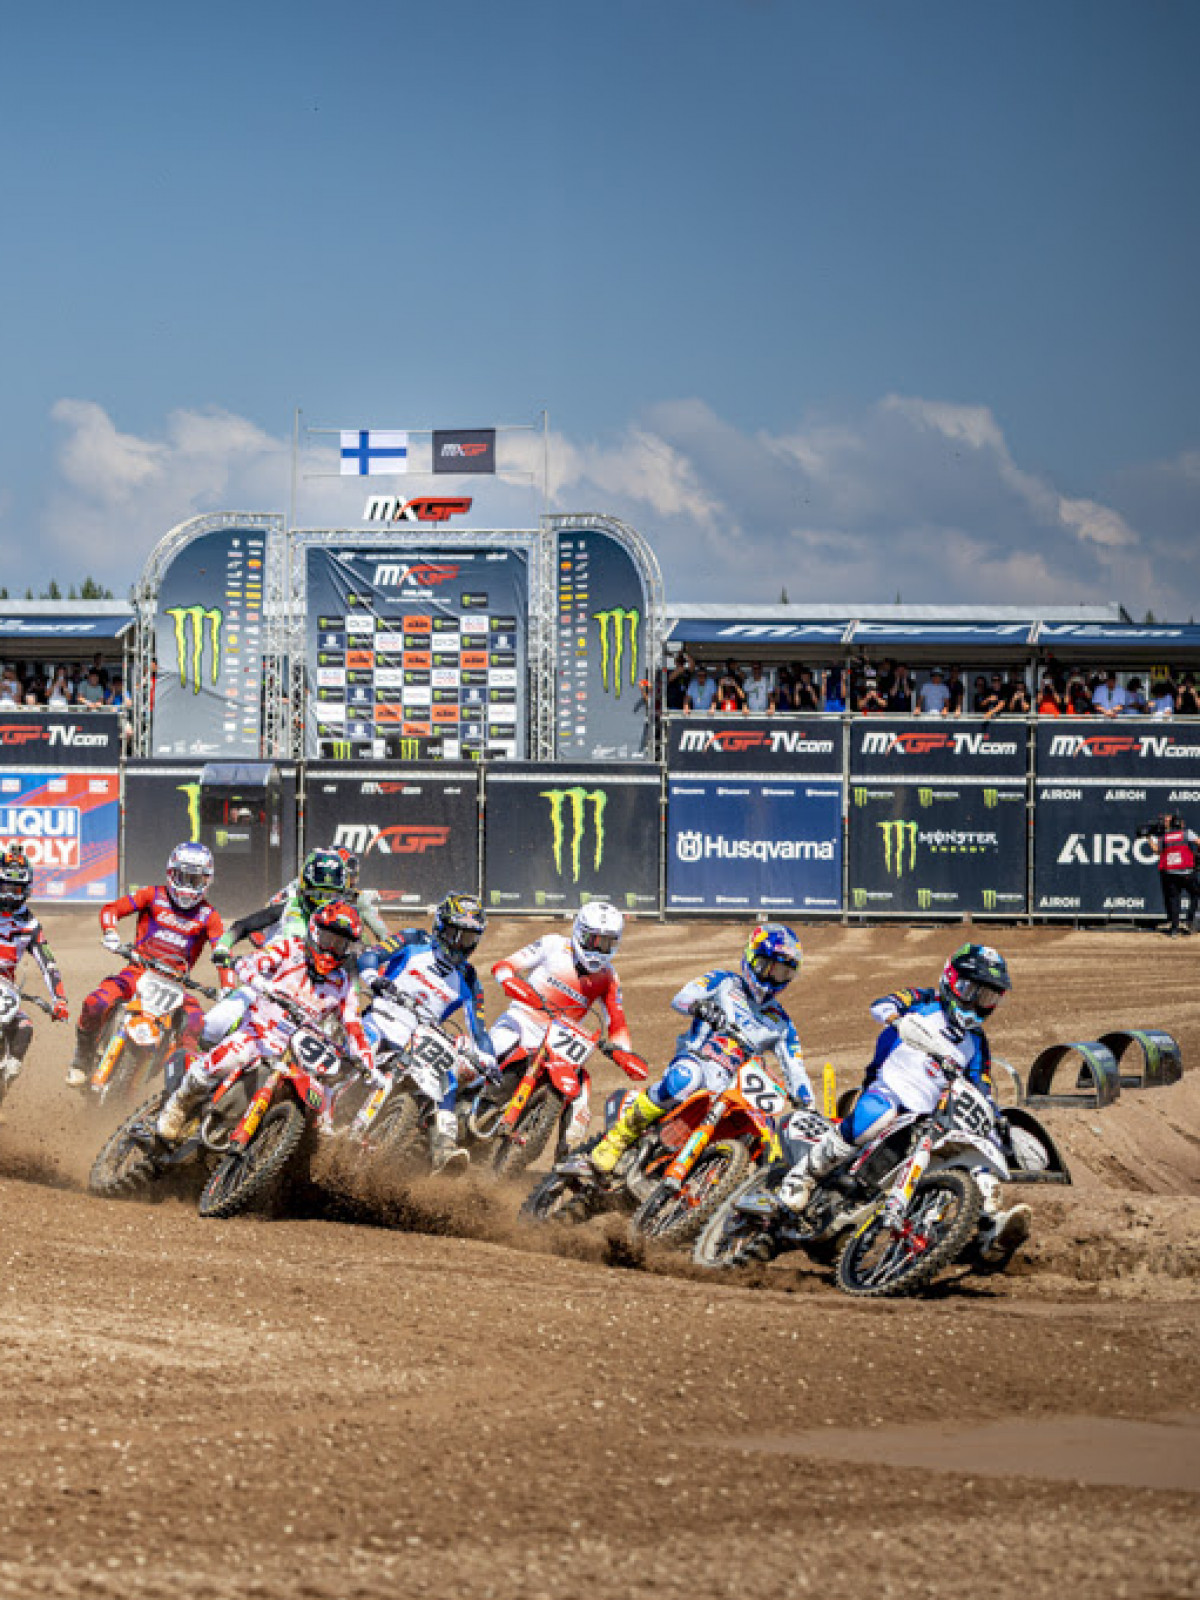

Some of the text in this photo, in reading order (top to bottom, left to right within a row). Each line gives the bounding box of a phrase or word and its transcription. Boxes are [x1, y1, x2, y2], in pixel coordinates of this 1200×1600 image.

[441, 443, 488, 456] MXGP
[362, 495, 472, 522] MXGP
[373, 563, 460, 585] MXGP
[1040, 789, 1082, 800] AIROH
[1104, 789, 1146, 801] AIROH
[332, 824, 451, 854] MXGP
[704, 834, 835, 862] Husqvarna
[918, 829, 998, 846] MONSTER
[1056, 833, 1160, 864] AIRO
[414, 1035, 454, 1074] 132
[552, 1031, 587, 1062] 70
[743, 1073, 778, 1114] 26
